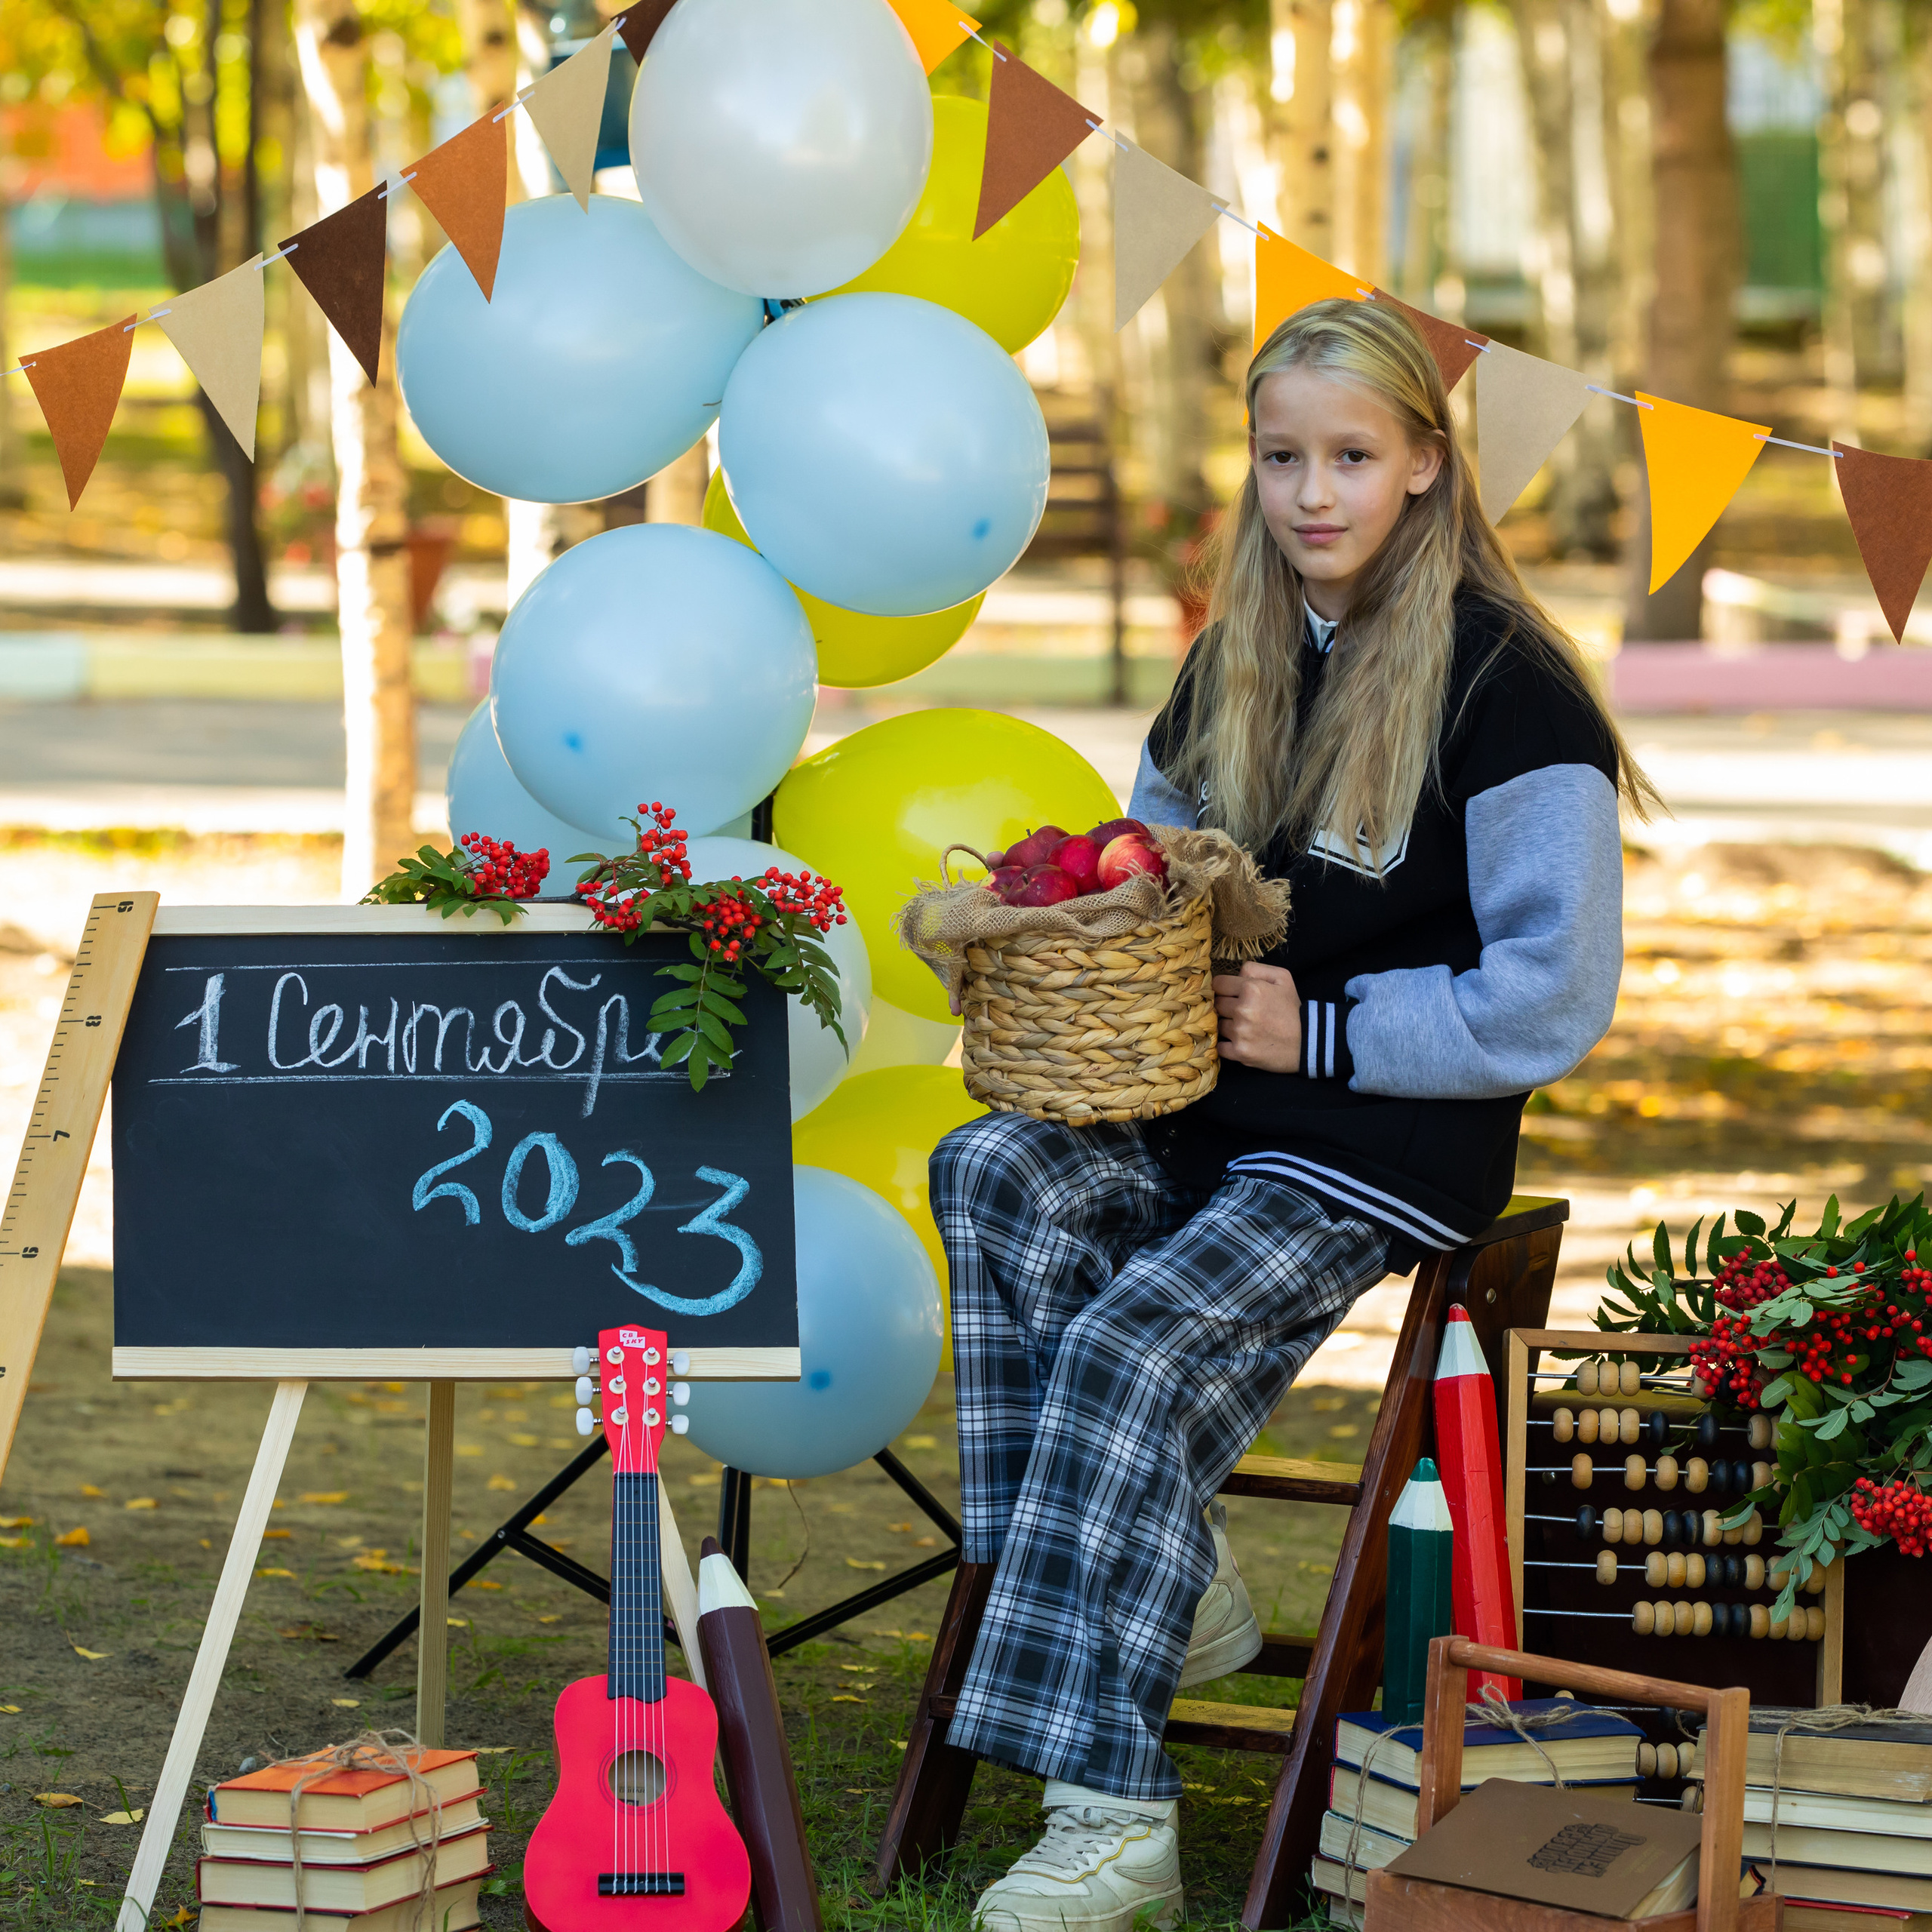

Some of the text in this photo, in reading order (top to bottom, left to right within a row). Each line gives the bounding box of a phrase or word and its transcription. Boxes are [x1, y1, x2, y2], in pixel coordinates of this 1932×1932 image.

[116, 900, 134, 913] 9
[85, 1014, 101, 1027] 8
[174, 973, 241, 1073] 1
[52, 1130, 70, 1142] 7
[413, 1099, 763, 1316] 2023
[21, 1246, 39, 1259] 6
